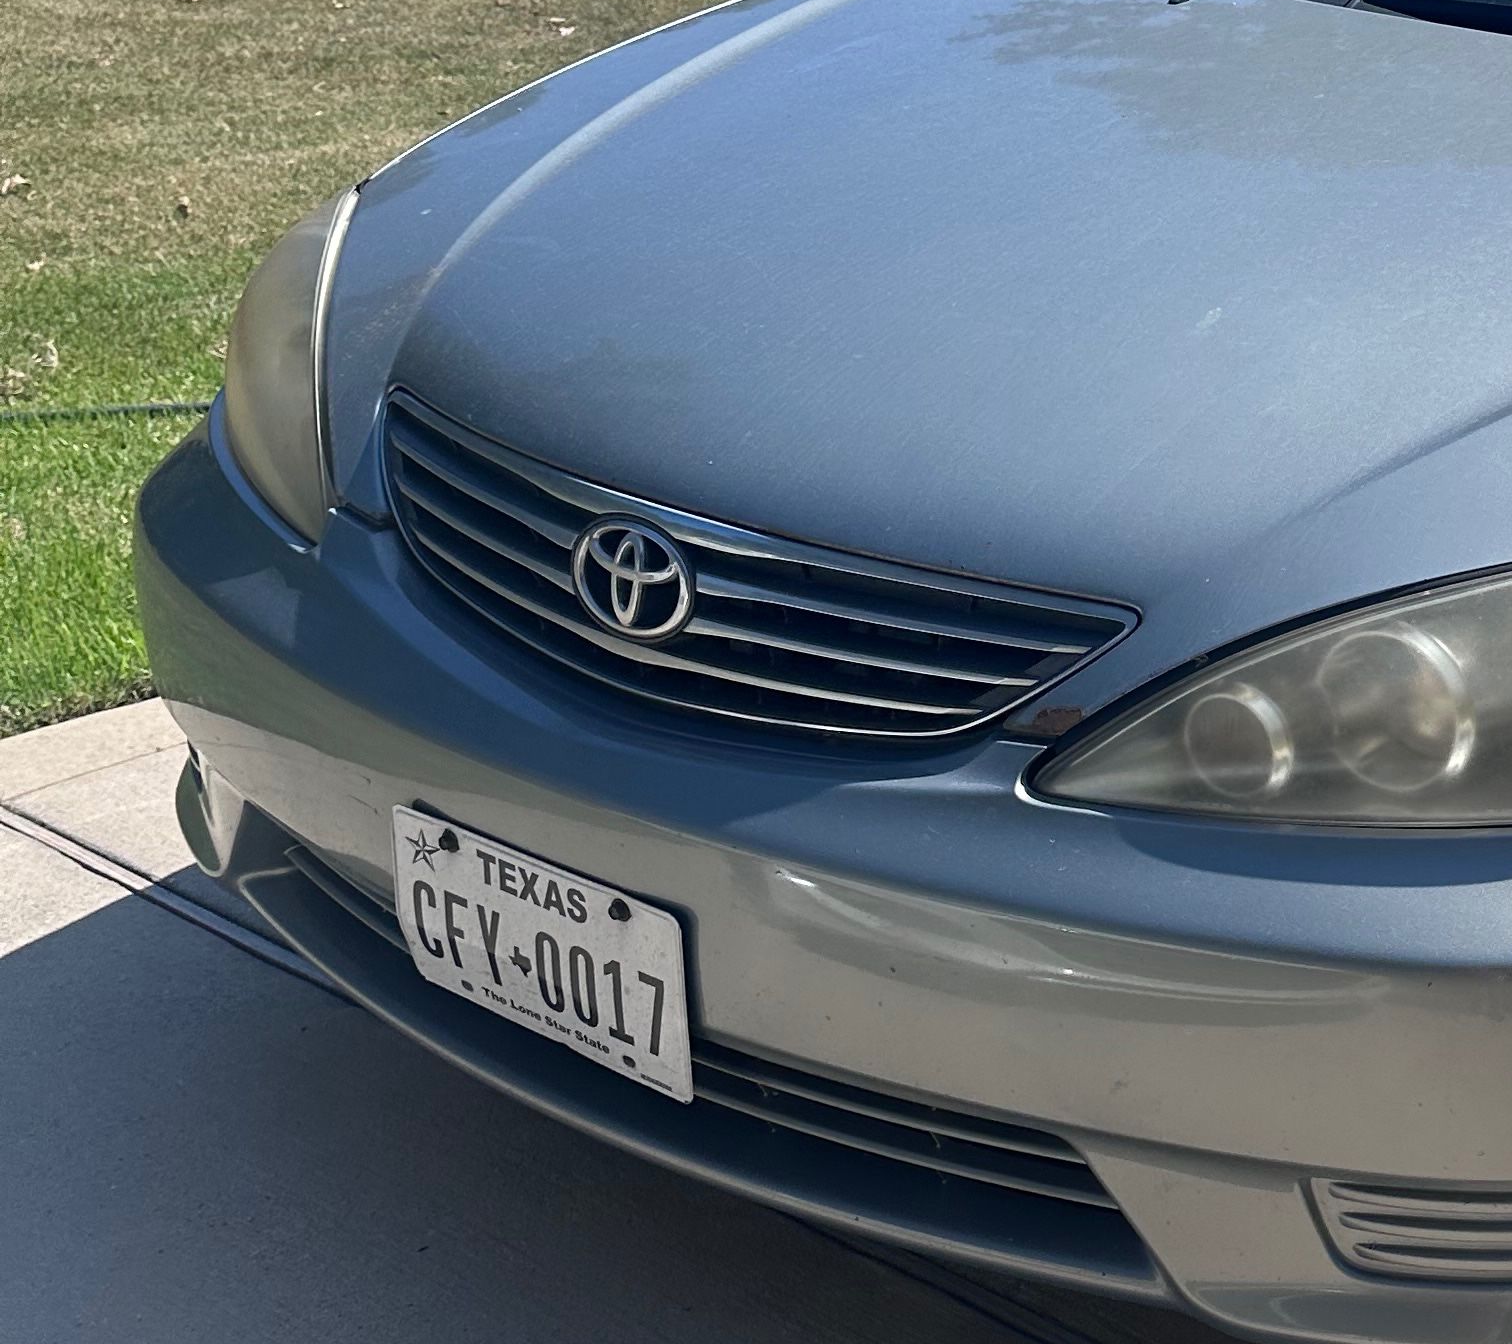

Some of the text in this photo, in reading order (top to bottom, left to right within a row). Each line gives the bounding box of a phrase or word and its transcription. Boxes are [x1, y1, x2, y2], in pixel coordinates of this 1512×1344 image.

[476, 849, 588, 924] TEXAS
[481, 986, 610, 1055] The Lone Star State
